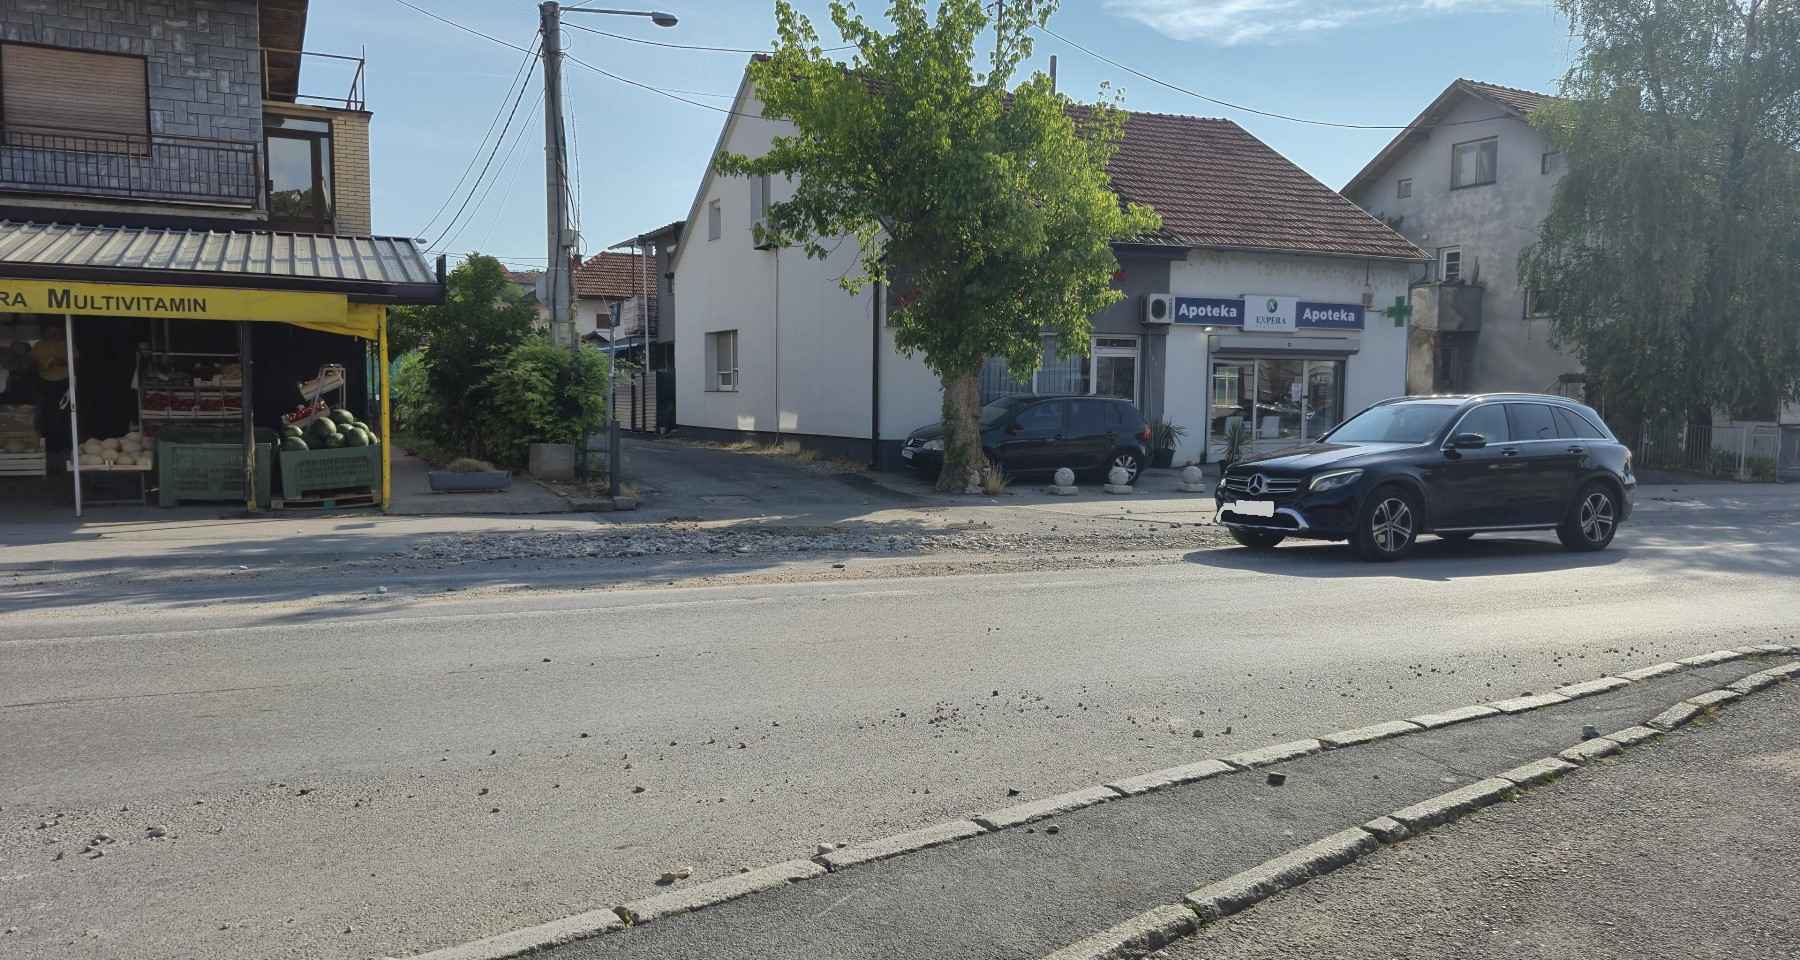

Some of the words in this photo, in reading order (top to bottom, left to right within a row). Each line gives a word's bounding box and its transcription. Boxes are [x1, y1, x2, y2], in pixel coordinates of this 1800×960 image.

[48, 288, 207, 312] MULTIVITAMIN
[1178, 303, 1238, 319] Apoteka
[1302, 307, 1356, 323] Apoteka
